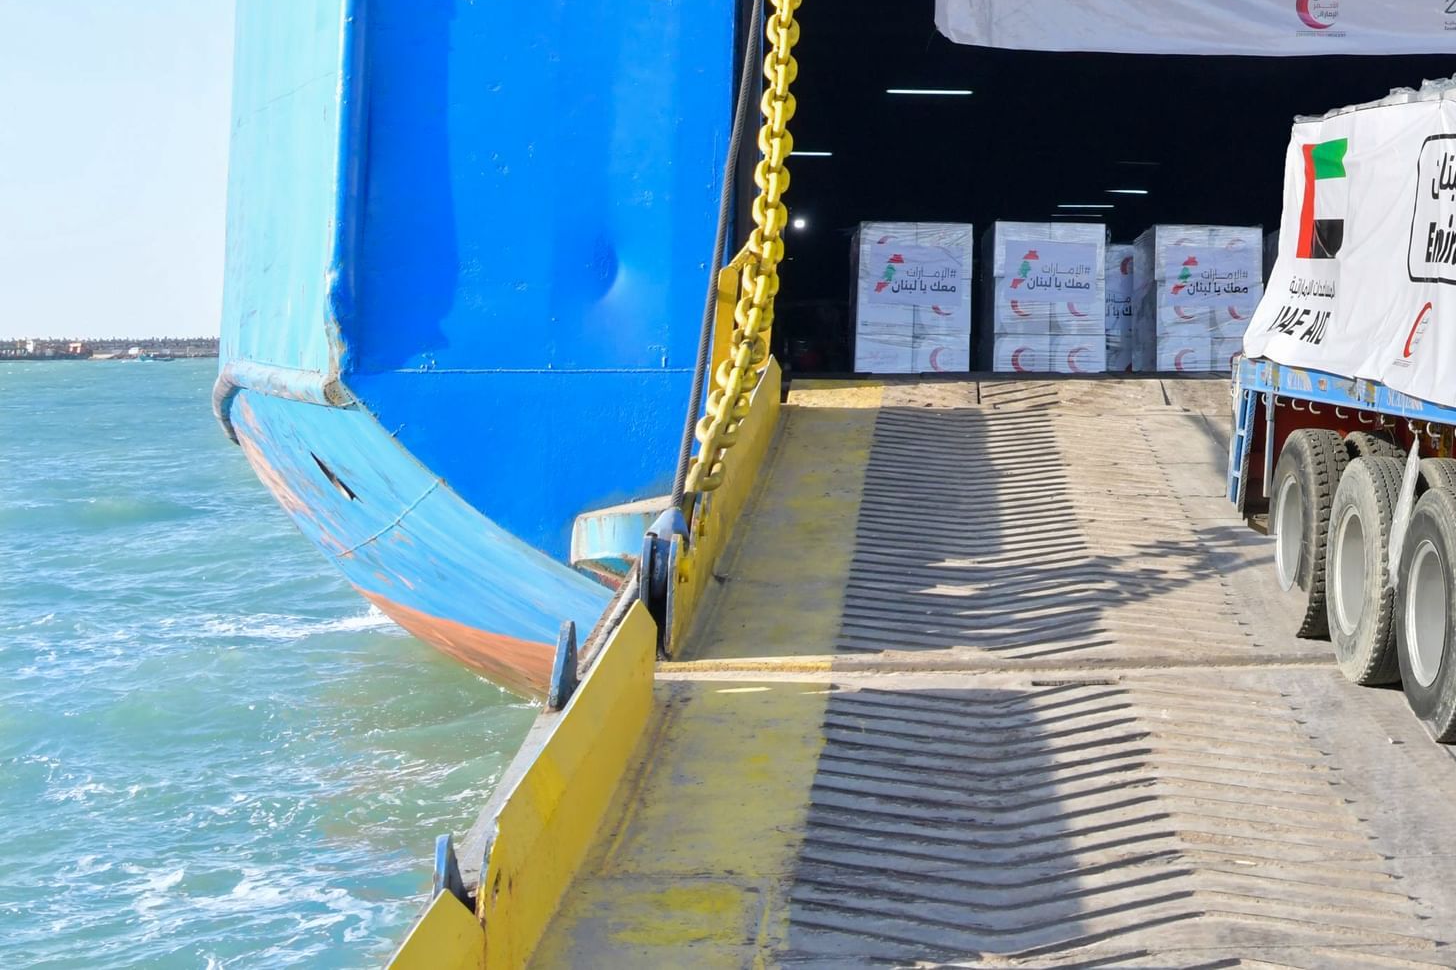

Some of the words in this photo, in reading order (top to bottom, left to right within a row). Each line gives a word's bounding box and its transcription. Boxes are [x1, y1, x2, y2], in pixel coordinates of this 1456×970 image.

[891, 280, 917, 293] لبنان
[1026, 276, 1052, 290] لبنان
[1187, 282, 1211, 296] لبنان
